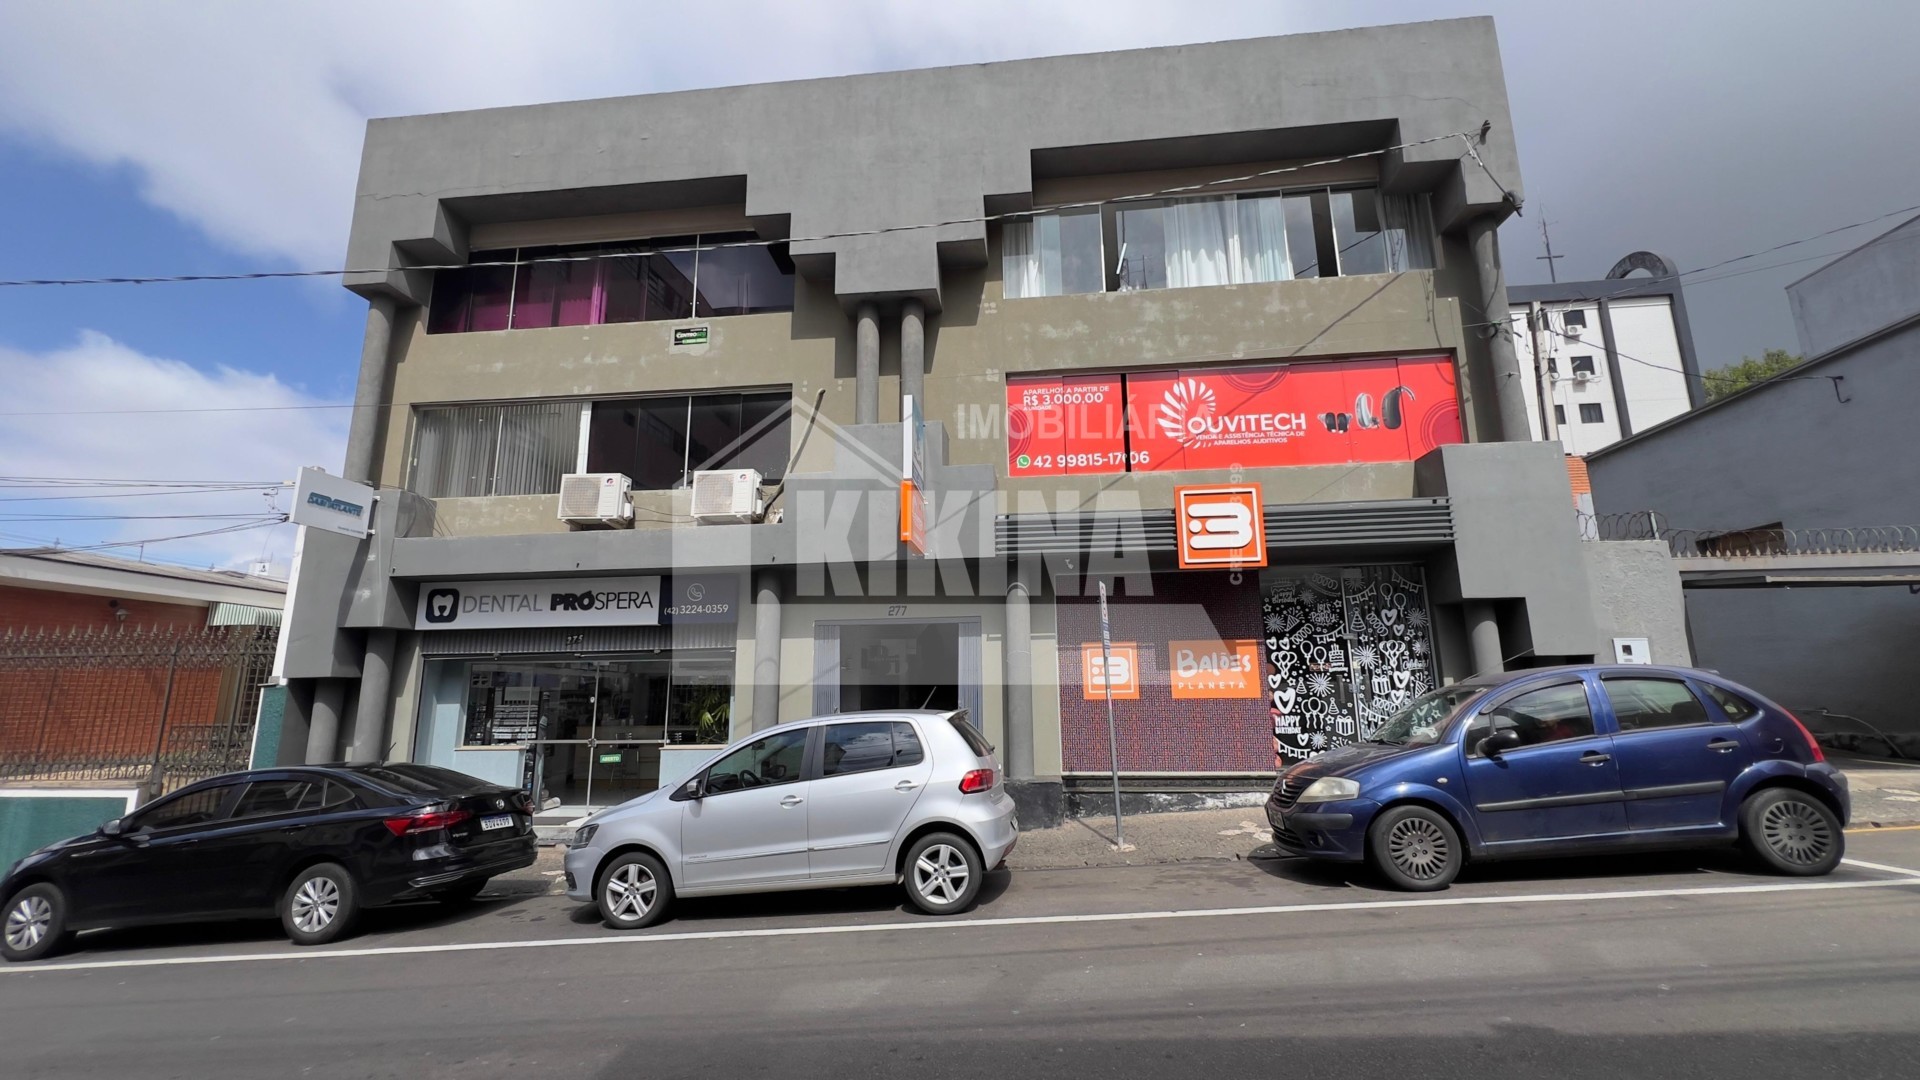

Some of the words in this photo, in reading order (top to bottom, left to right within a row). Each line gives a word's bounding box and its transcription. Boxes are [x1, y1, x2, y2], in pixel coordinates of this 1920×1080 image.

[1023, 387, 1065, 395] APARELHOS
[1023, 394, 1039, 406] R$
[1187, 413, 1307, 434] OUVITECH
[1224, 431, 1265, 439] ASSISTÊNCIA
[1033, 455, 1052, 468] 42
[462, 594, 543, 614] DENTAL
[663, 607, 679, 615] (42)
[680, 604, 729, 614] 3224-0359
[888, 605, 908, 616] 277
[1178, 681, 1245, 690] PLANETA
[1275, 715, 1300, 727] HAPPY
[1275, 726, 1301, 734] BIRTHDAY
